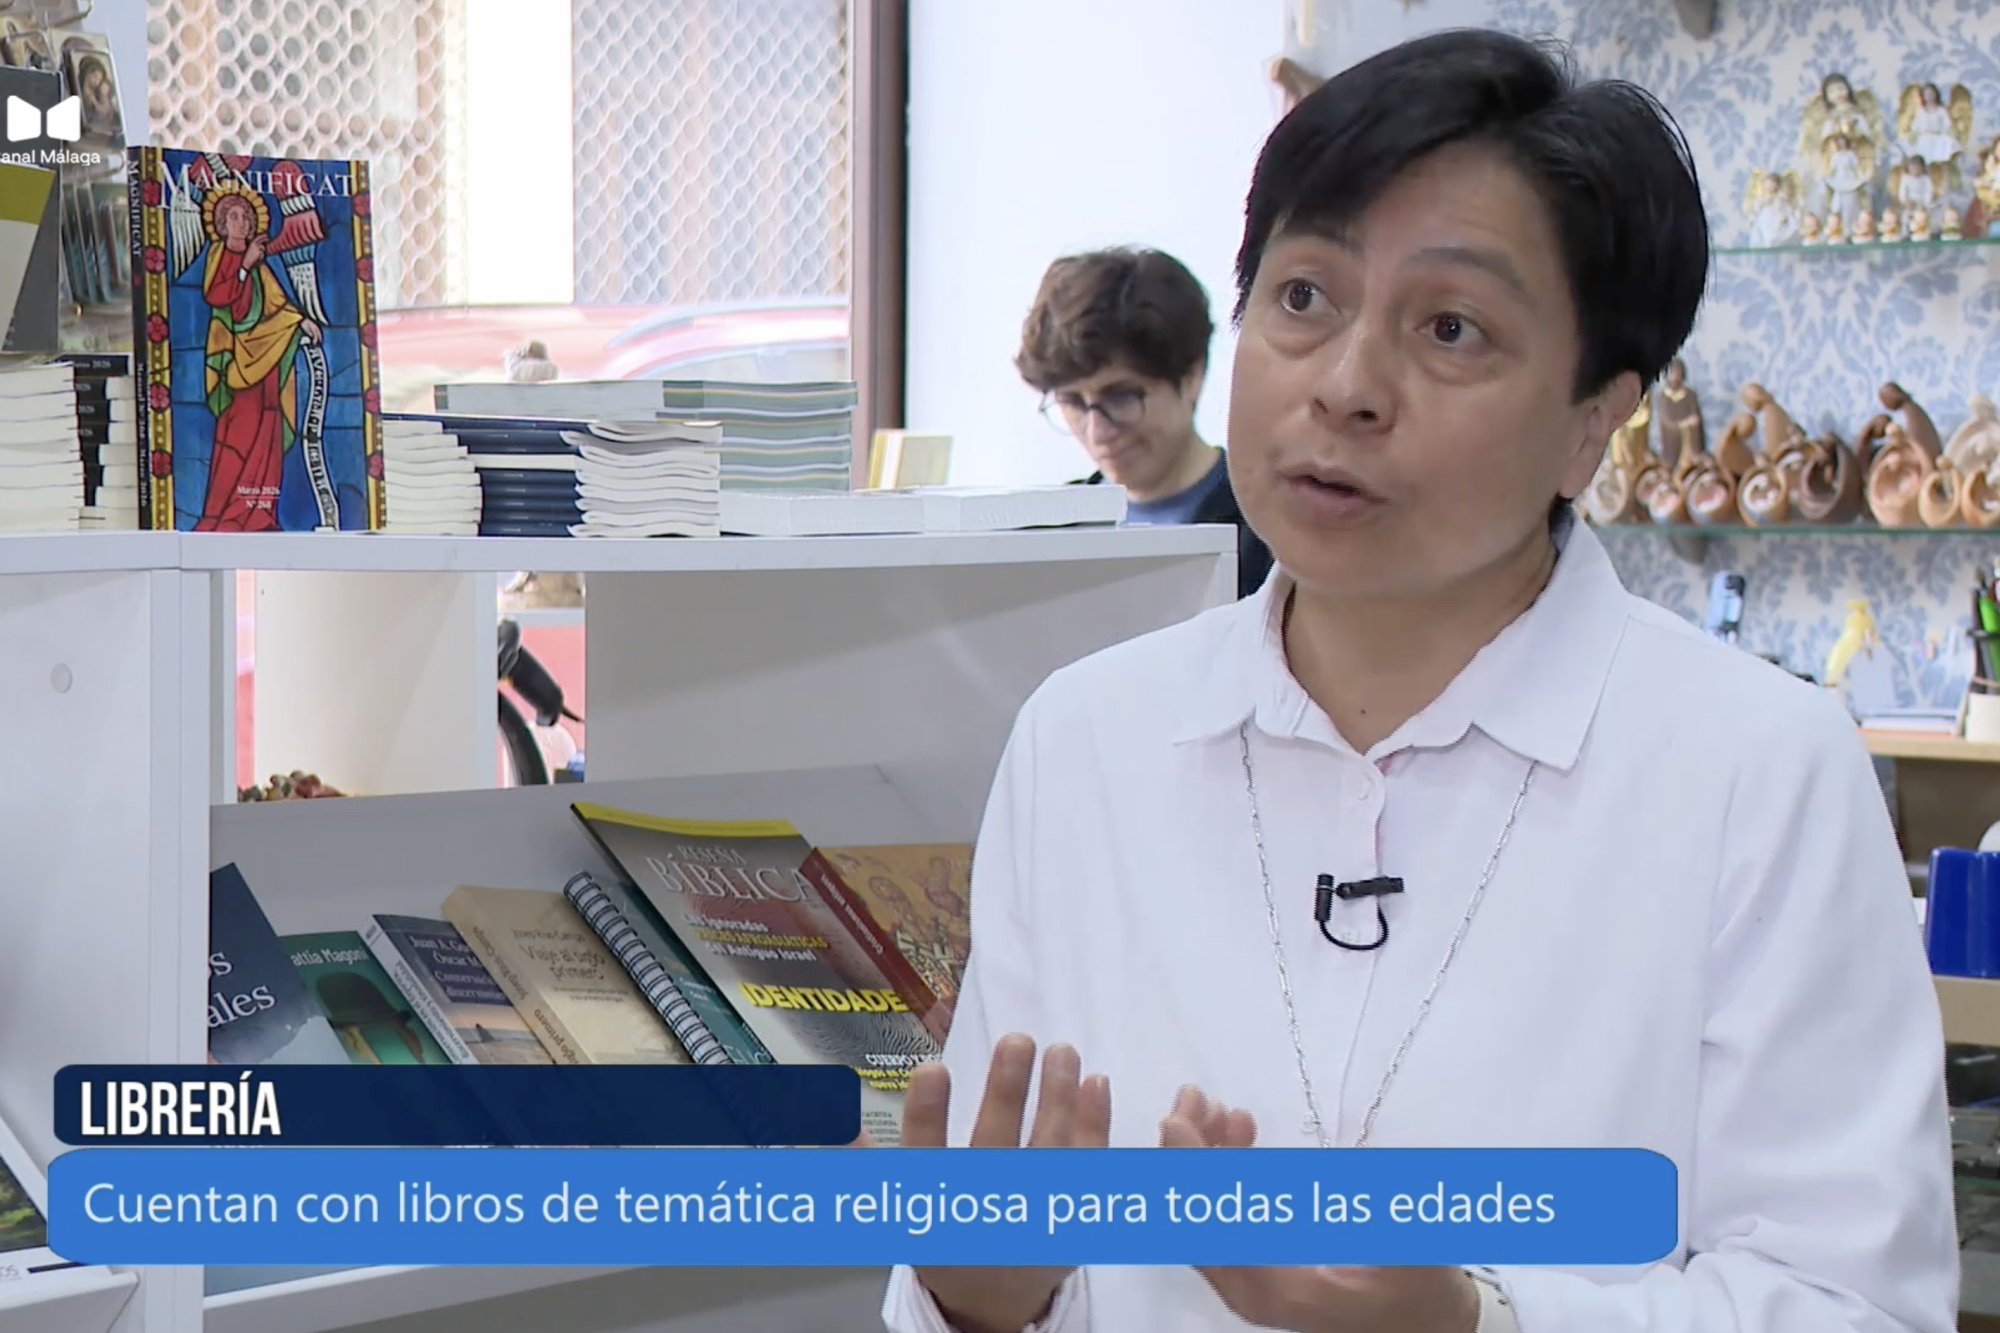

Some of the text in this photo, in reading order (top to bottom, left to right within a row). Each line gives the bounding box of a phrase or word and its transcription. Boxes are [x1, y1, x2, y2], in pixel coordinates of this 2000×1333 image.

[158, 160, 354, 209] MAGNIFICAT
[127, 159, 142, 258] MAGNIFICAT
[677, 845, 747, 864] RESEÑA
[646, 853, 816, 903] BÍBLICA
[291, 950, 321, 966] attia
[410, 935, 438, 949] Juan
[208, 951, 233, 978] s
[534, 1009, 565, 1048] primero
